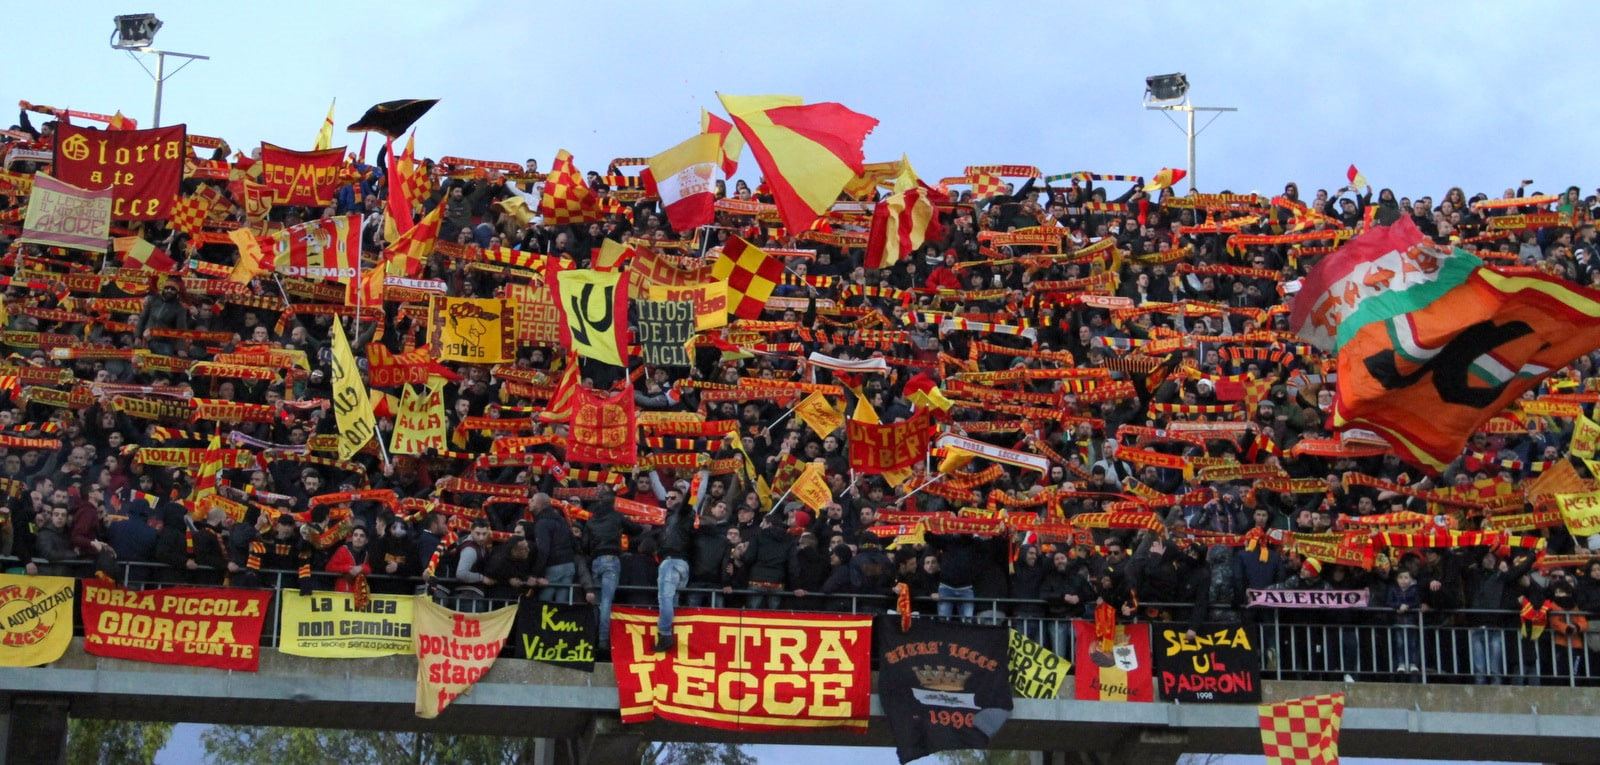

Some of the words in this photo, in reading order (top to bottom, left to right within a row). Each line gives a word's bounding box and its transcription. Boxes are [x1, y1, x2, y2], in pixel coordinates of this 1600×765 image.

[61, 133, 180, 165] Gloria
[90, 171, 103, 184] a
[114, 170, 135, 186] te
[113, 198, 160, 216] cce
[35, 213, 106, 236] AMORE
[1232, 266, 1275, 277] NORD
[105, 299, 142, 313] ORZA
[636, 300, 695, 321] TIFOSI
[638, 321, 696, 343] DELLA
[19, 368, 59, 382] LECCE
[371, 368, 389, 385] NO
[393, 366, 429, 384] BUSIN
[400, 413, 441, 431] ALLA
[395, 432, 443, 454] FINE
[145, 448, 187, 464] FORZA
[656, 453, 692, 466] LECCE
[1111, 512, 1151, 526] LECCE
[7, 586, 74, 628] AUTORIZZATO
[86, 586, 156, 611] FORZA
[161, 595, 260, 617] PICCOLA
[1251, 590, 1361, 605] PALERMO
[98, 611, 235, 643] GIORGIA
[298, 621, 334, 637] non
[340, 619, 411, 638] cambia
[452, 613, 481, 638] In
[541, 604, 584, 632] Km.
[184, 642, 224, 656] CON
[230, 643, 254, 659] TE
[348, 640, 376, 649] senza
[377, 641, 410, 651] padroni
[419, 633, 506, 661] poltron
[522, 634, 594, 662] Vietati
[1013, 632, 1059, 670] SOLO
[1163, 627, 1252, 656] SENZA
[1192, 652, 1226, 674] UL
[1033, 667, 1057, 688] LA
[1163, 670, 1253, 695] PADRONI
[629, 662, 853, 718] LECCE
[1196, 691, 1213, 700] 1998
